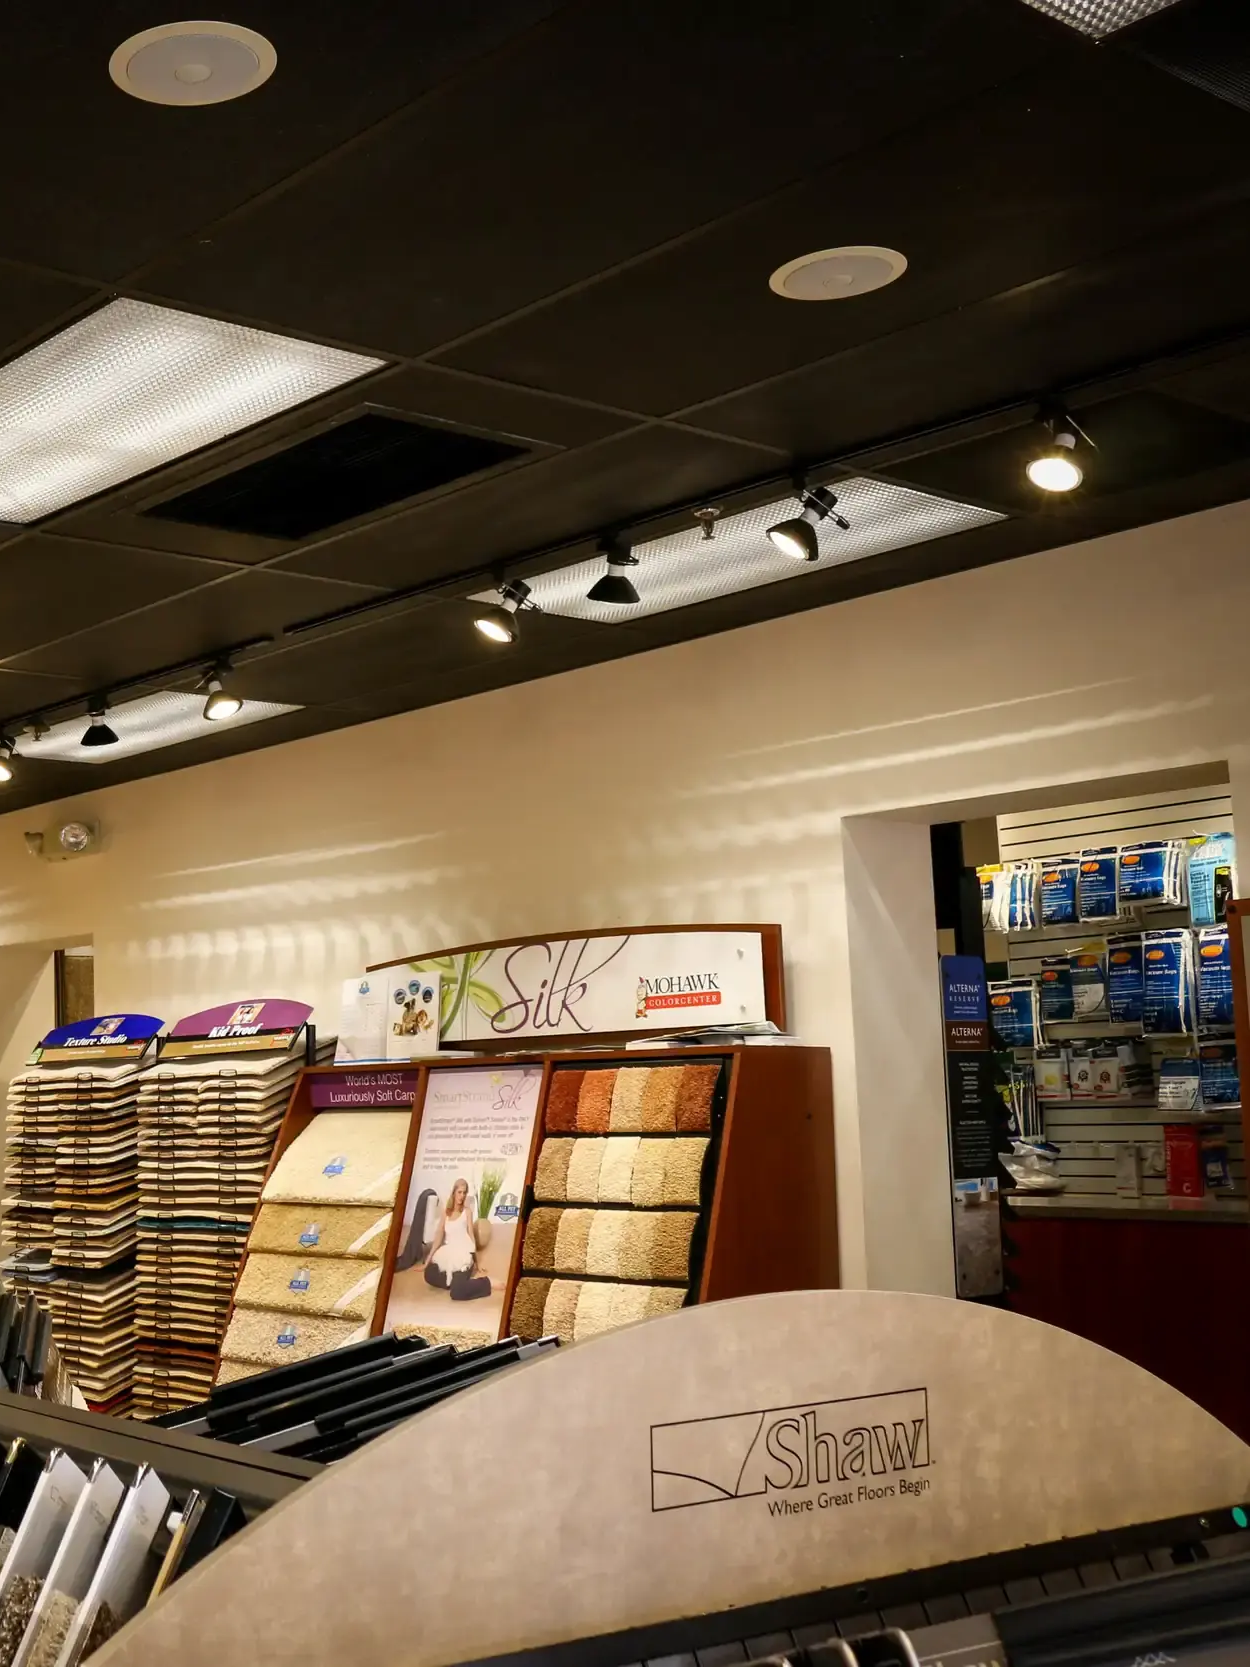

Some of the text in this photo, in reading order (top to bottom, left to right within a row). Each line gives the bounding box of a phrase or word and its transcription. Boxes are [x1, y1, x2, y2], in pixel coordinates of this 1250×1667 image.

[491, 936, 630, 1034] Silk
[645, 973, 720, 994] MOHAWK
[949, 984, 980, 993] ALTERNA
[648, 994, 718, 1007] COLORCENTER
[208, 1023, 264, 1038] Kid Proof
[951, 1027, 982, 1037] ALTERNA
[63, 1034, 127, 1047] Texture Studio
[345, 1073, 403, 1086] World's MOST
[330, 1091, 375, 1104] Luxuriously
[376, 1090, 394, 1102] Soft
[765, 1410, 930, 1494] Shaw
[767, 1477, 931, 1518] Where Great Floors Begin
